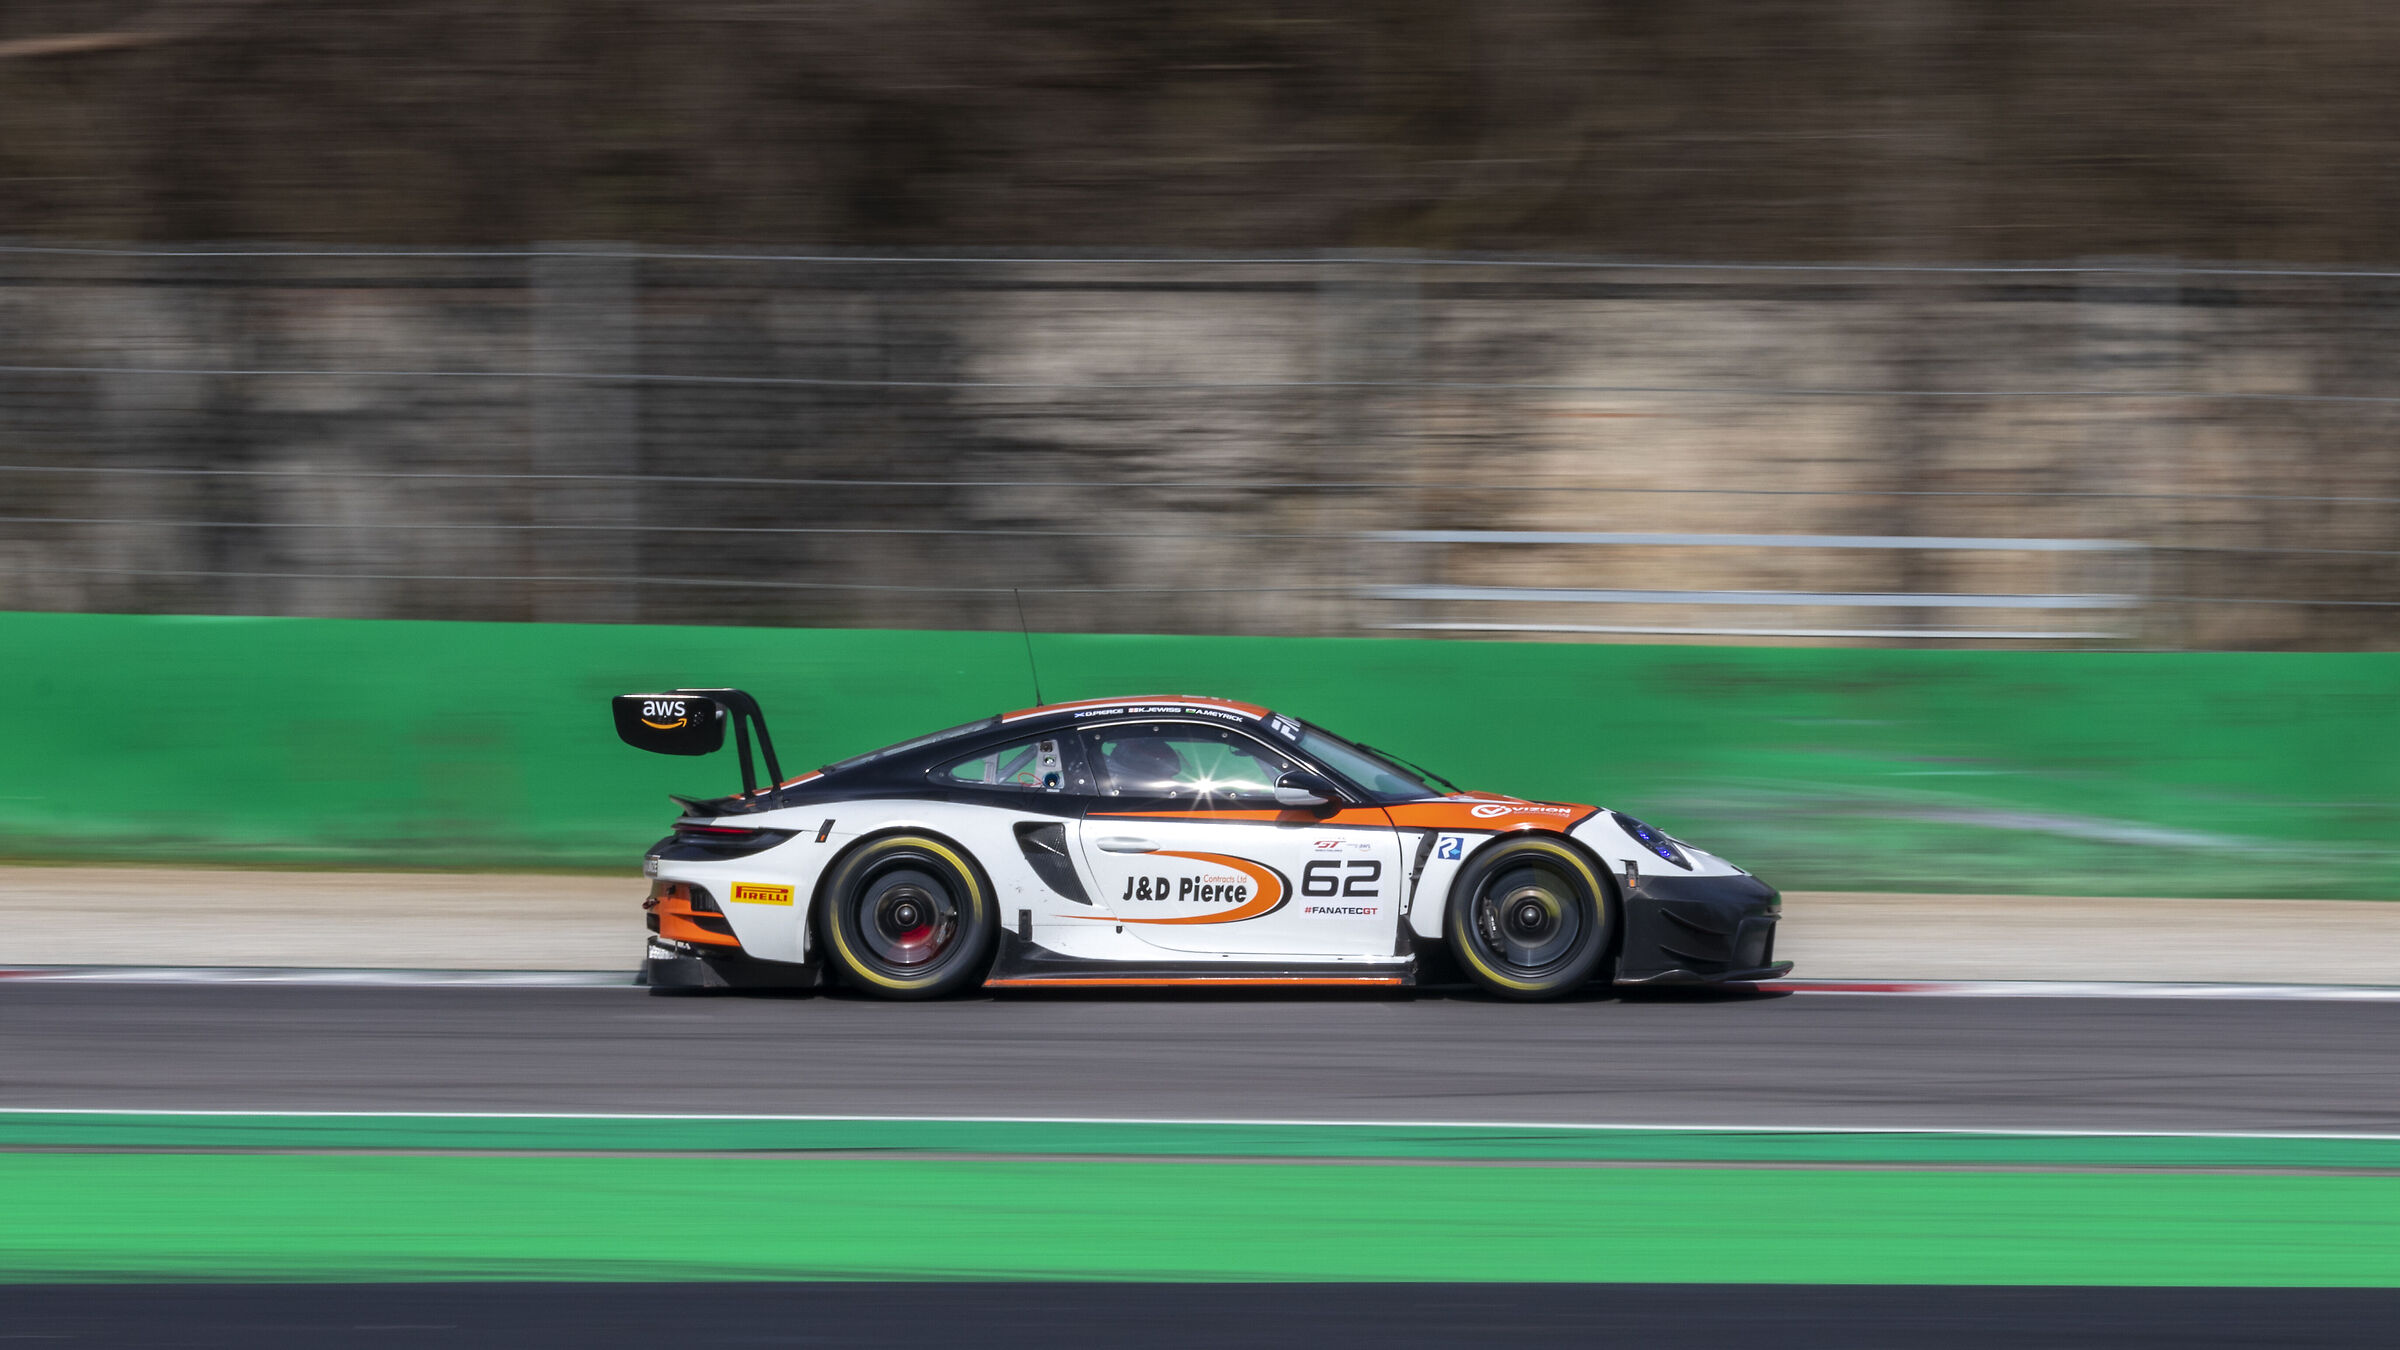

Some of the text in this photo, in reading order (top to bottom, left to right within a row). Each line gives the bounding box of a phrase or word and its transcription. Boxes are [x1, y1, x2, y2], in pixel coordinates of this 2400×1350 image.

[643, 700, 686, 717] aws
[1203, 874, 1248, 884] Contracts Ltd
[1301, 860, 1382, 897] 62
[735, 885, 789, 902] PIRELLI
[1122, 875, 1247, 903] J&D Pierce
[1304, 906, 1378, 915] #FANATECGT
